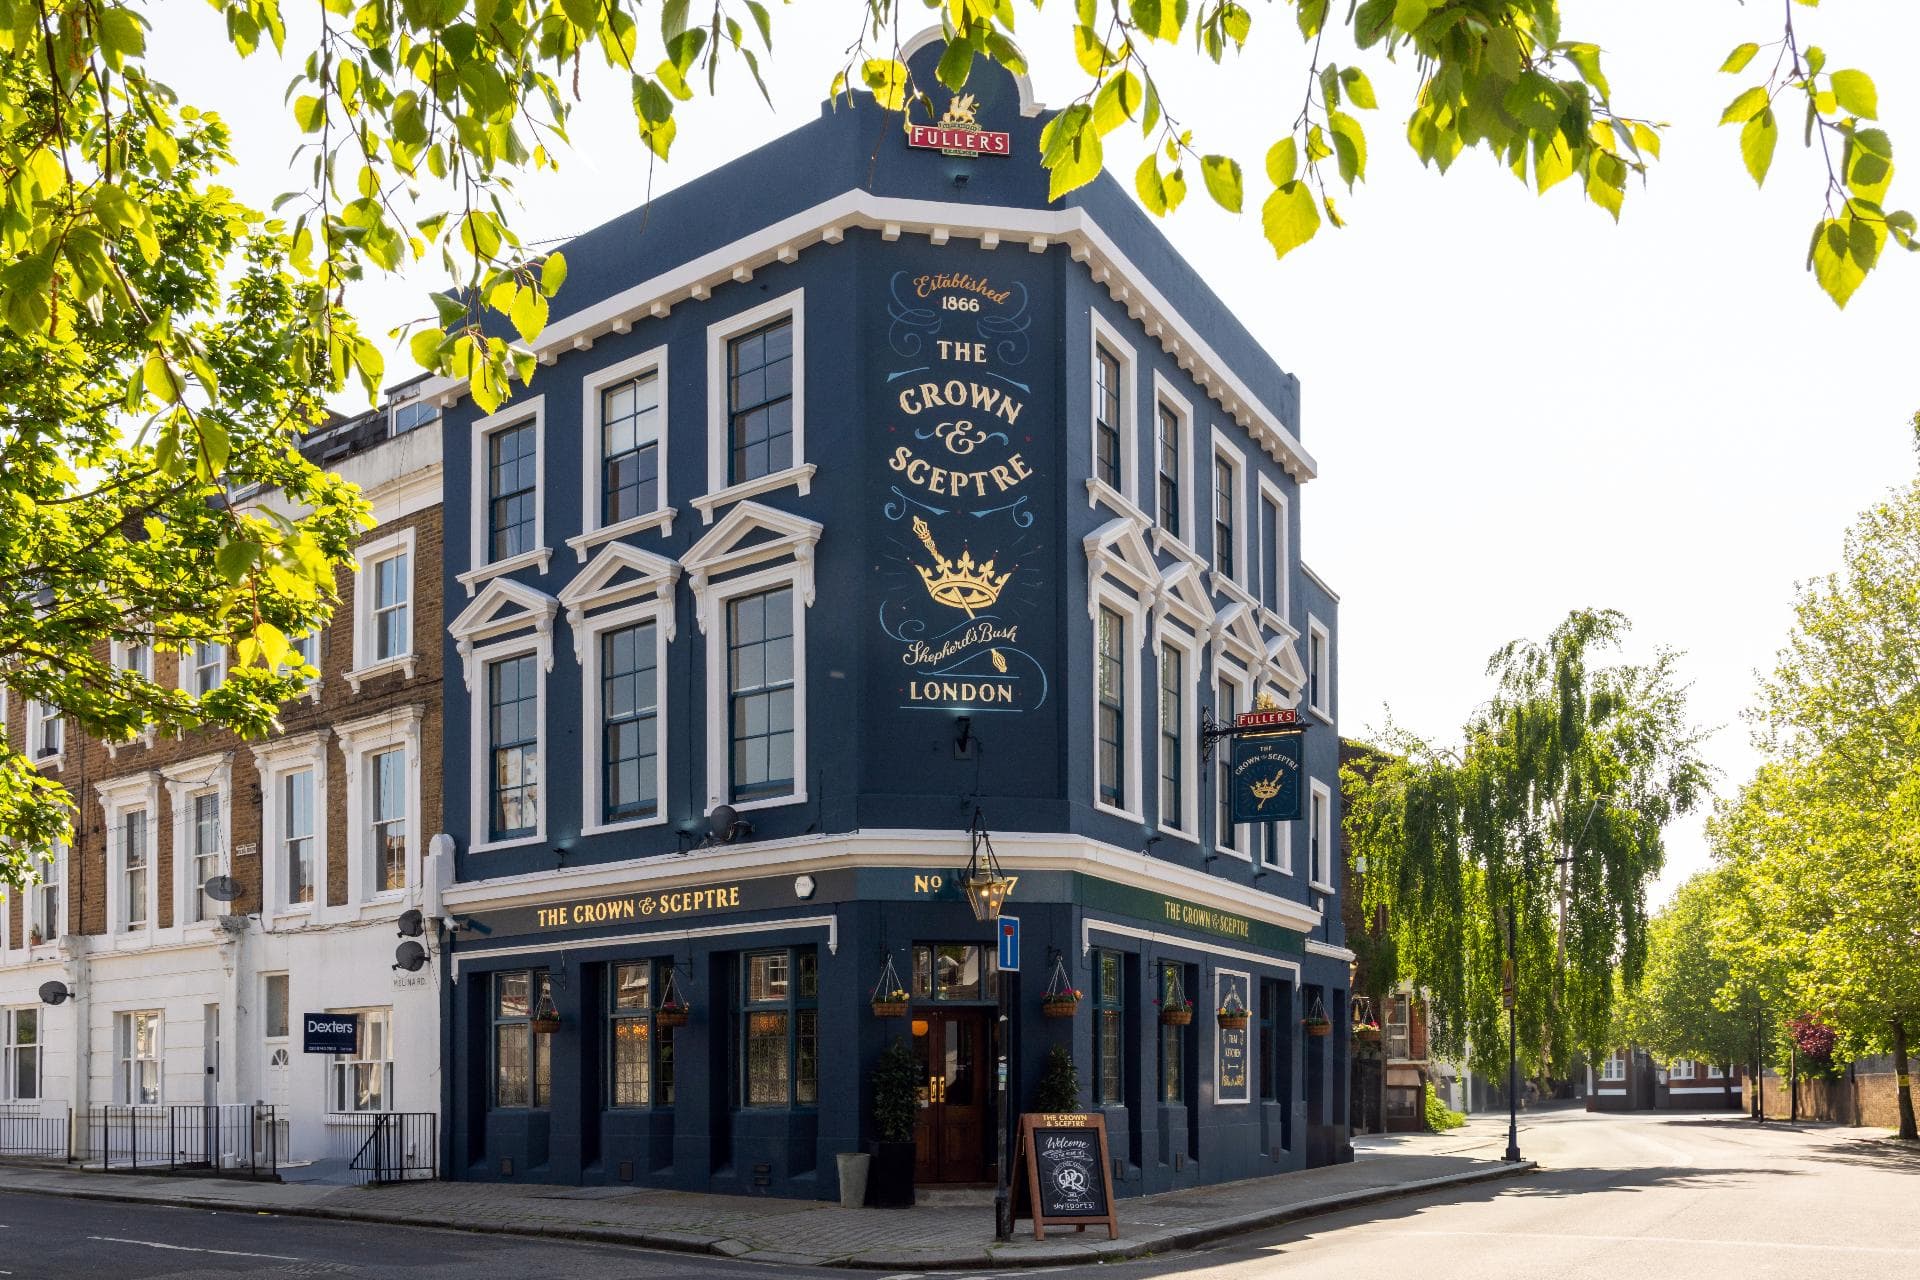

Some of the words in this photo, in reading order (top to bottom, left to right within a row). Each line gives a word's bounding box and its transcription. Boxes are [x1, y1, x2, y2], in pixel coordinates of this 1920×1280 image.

[914, 127, 1004, 151] FULLER'S
[913, 272, 1013, 305] Established
[942, 295, 980, 312] 1866
[936, 340, 987, 363] THE
[900, 380, 1024, 425] CROWN
[935, 420, 987, 455] &
[888, 446, 1034, 497] SCEPTRE
[902, 627, 978, 666] Shepherd's
[978, 622, 1018, 643] Bush
[910, 681, 1012, 702] LONDON
[1235, 755, 1260, 775] CROWN
[1267, 753, 1298, 771] SCEPTRE
[537, 907, 568, 927] THE
[573, 899, 635, 924] CROWN
[638, 897, 656, 915] &
[659, 886, 740, 914] SCEPTRE
[1164, 901, 1181, 921] THE
[1182, 906, 1210, 928] CROWN
[1219, 915, 1249, 937] SCEPTRE
[308, 1020, 353, 1033] Dexters
[1045, 1136, 1089, 1149] Welcome
